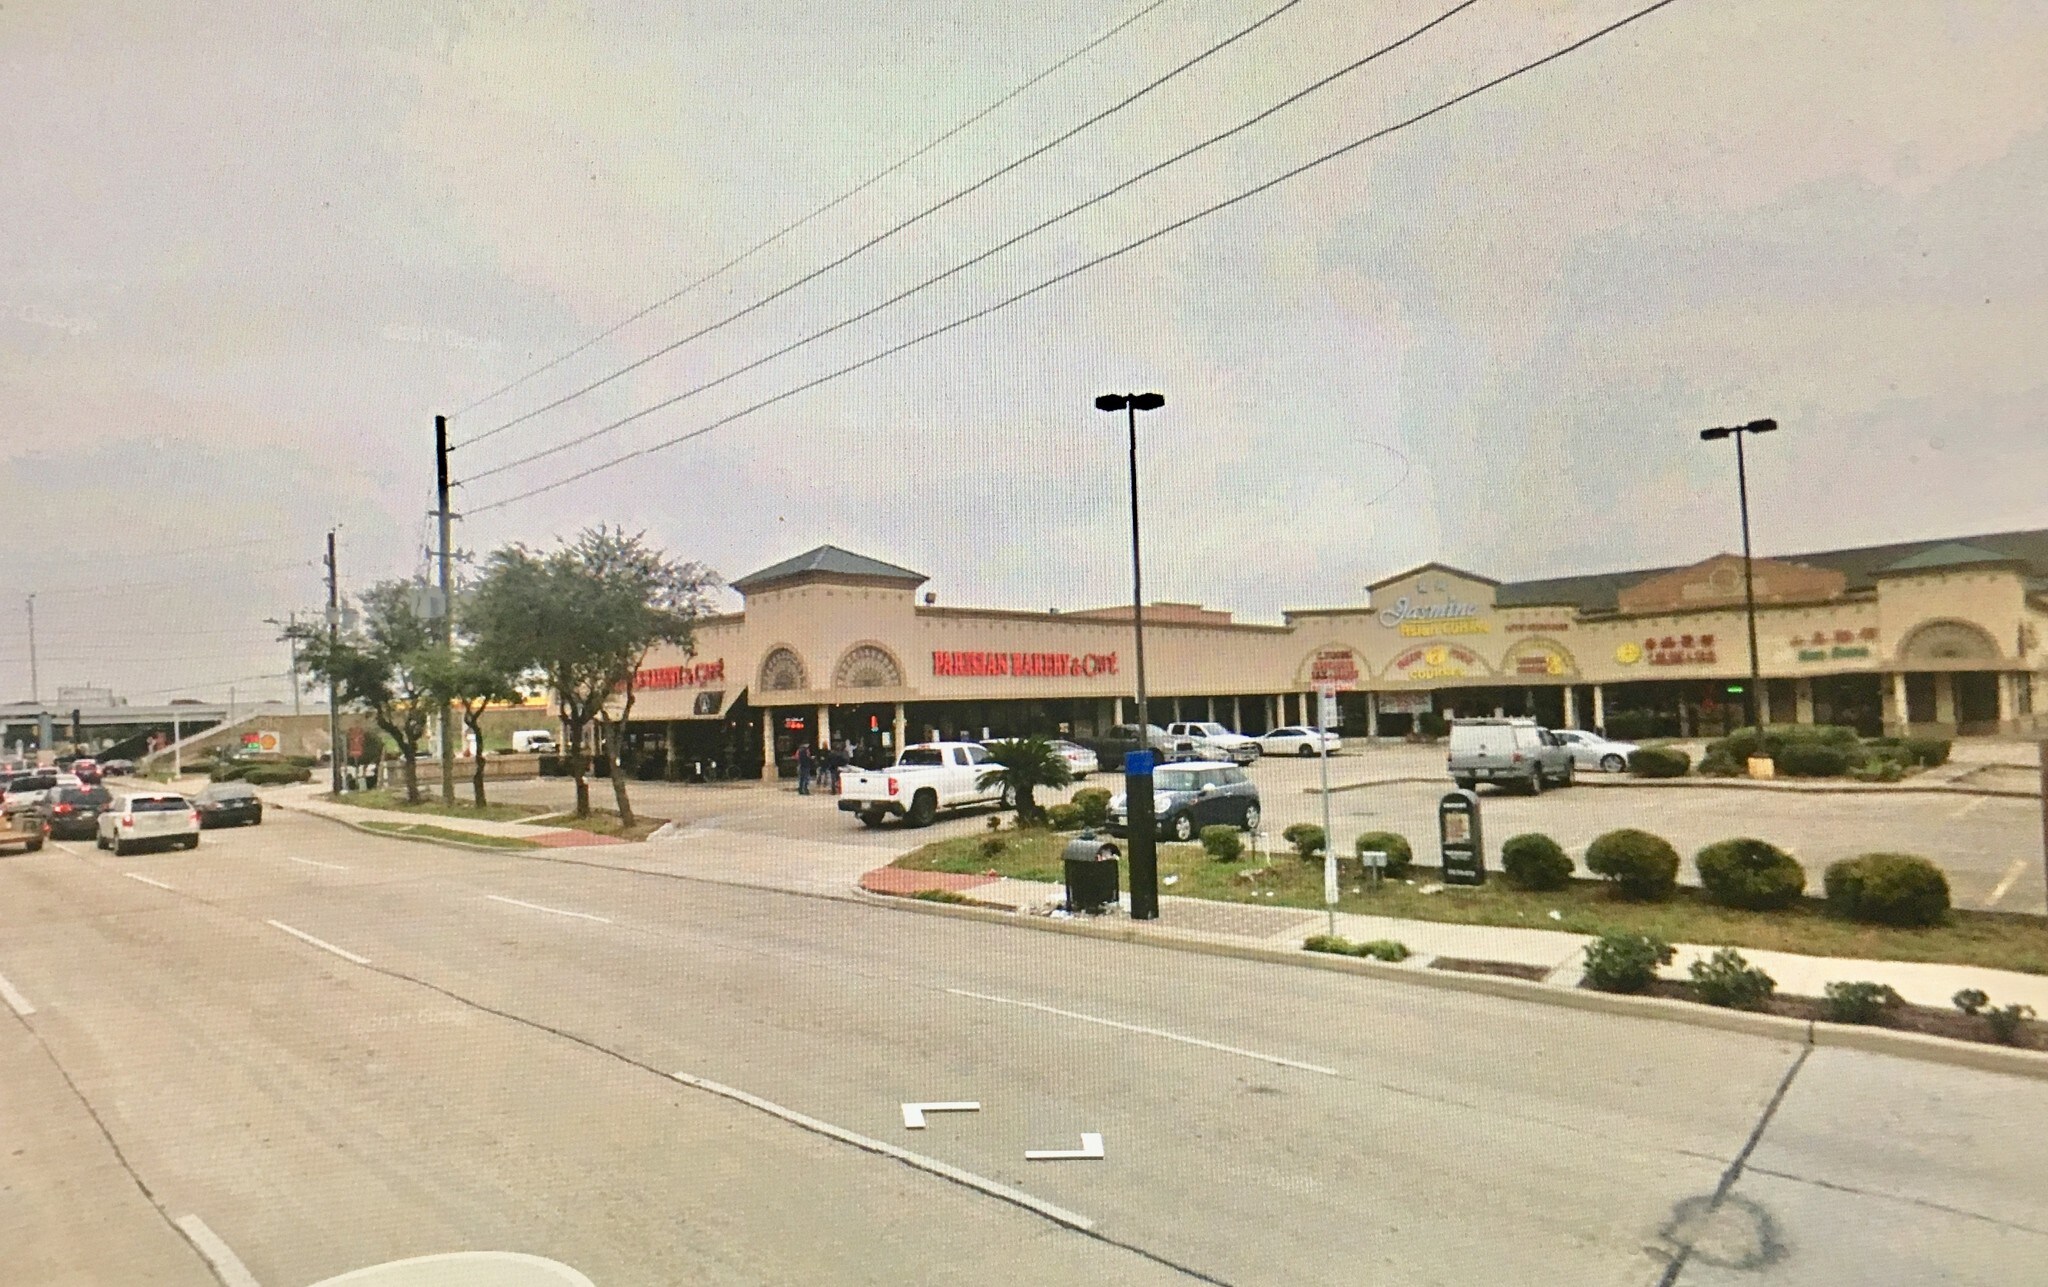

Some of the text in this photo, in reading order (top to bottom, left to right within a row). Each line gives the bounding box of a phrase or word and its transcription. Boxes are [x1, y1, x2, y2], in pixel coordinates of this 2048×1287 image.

[1380, 597, 1478, 628] Jasmine
[932, 650, 1008, 677] PARISIAN
[1010, 651, 1070, 678] BAKERY
[1070, 656, 1082, 677] &
